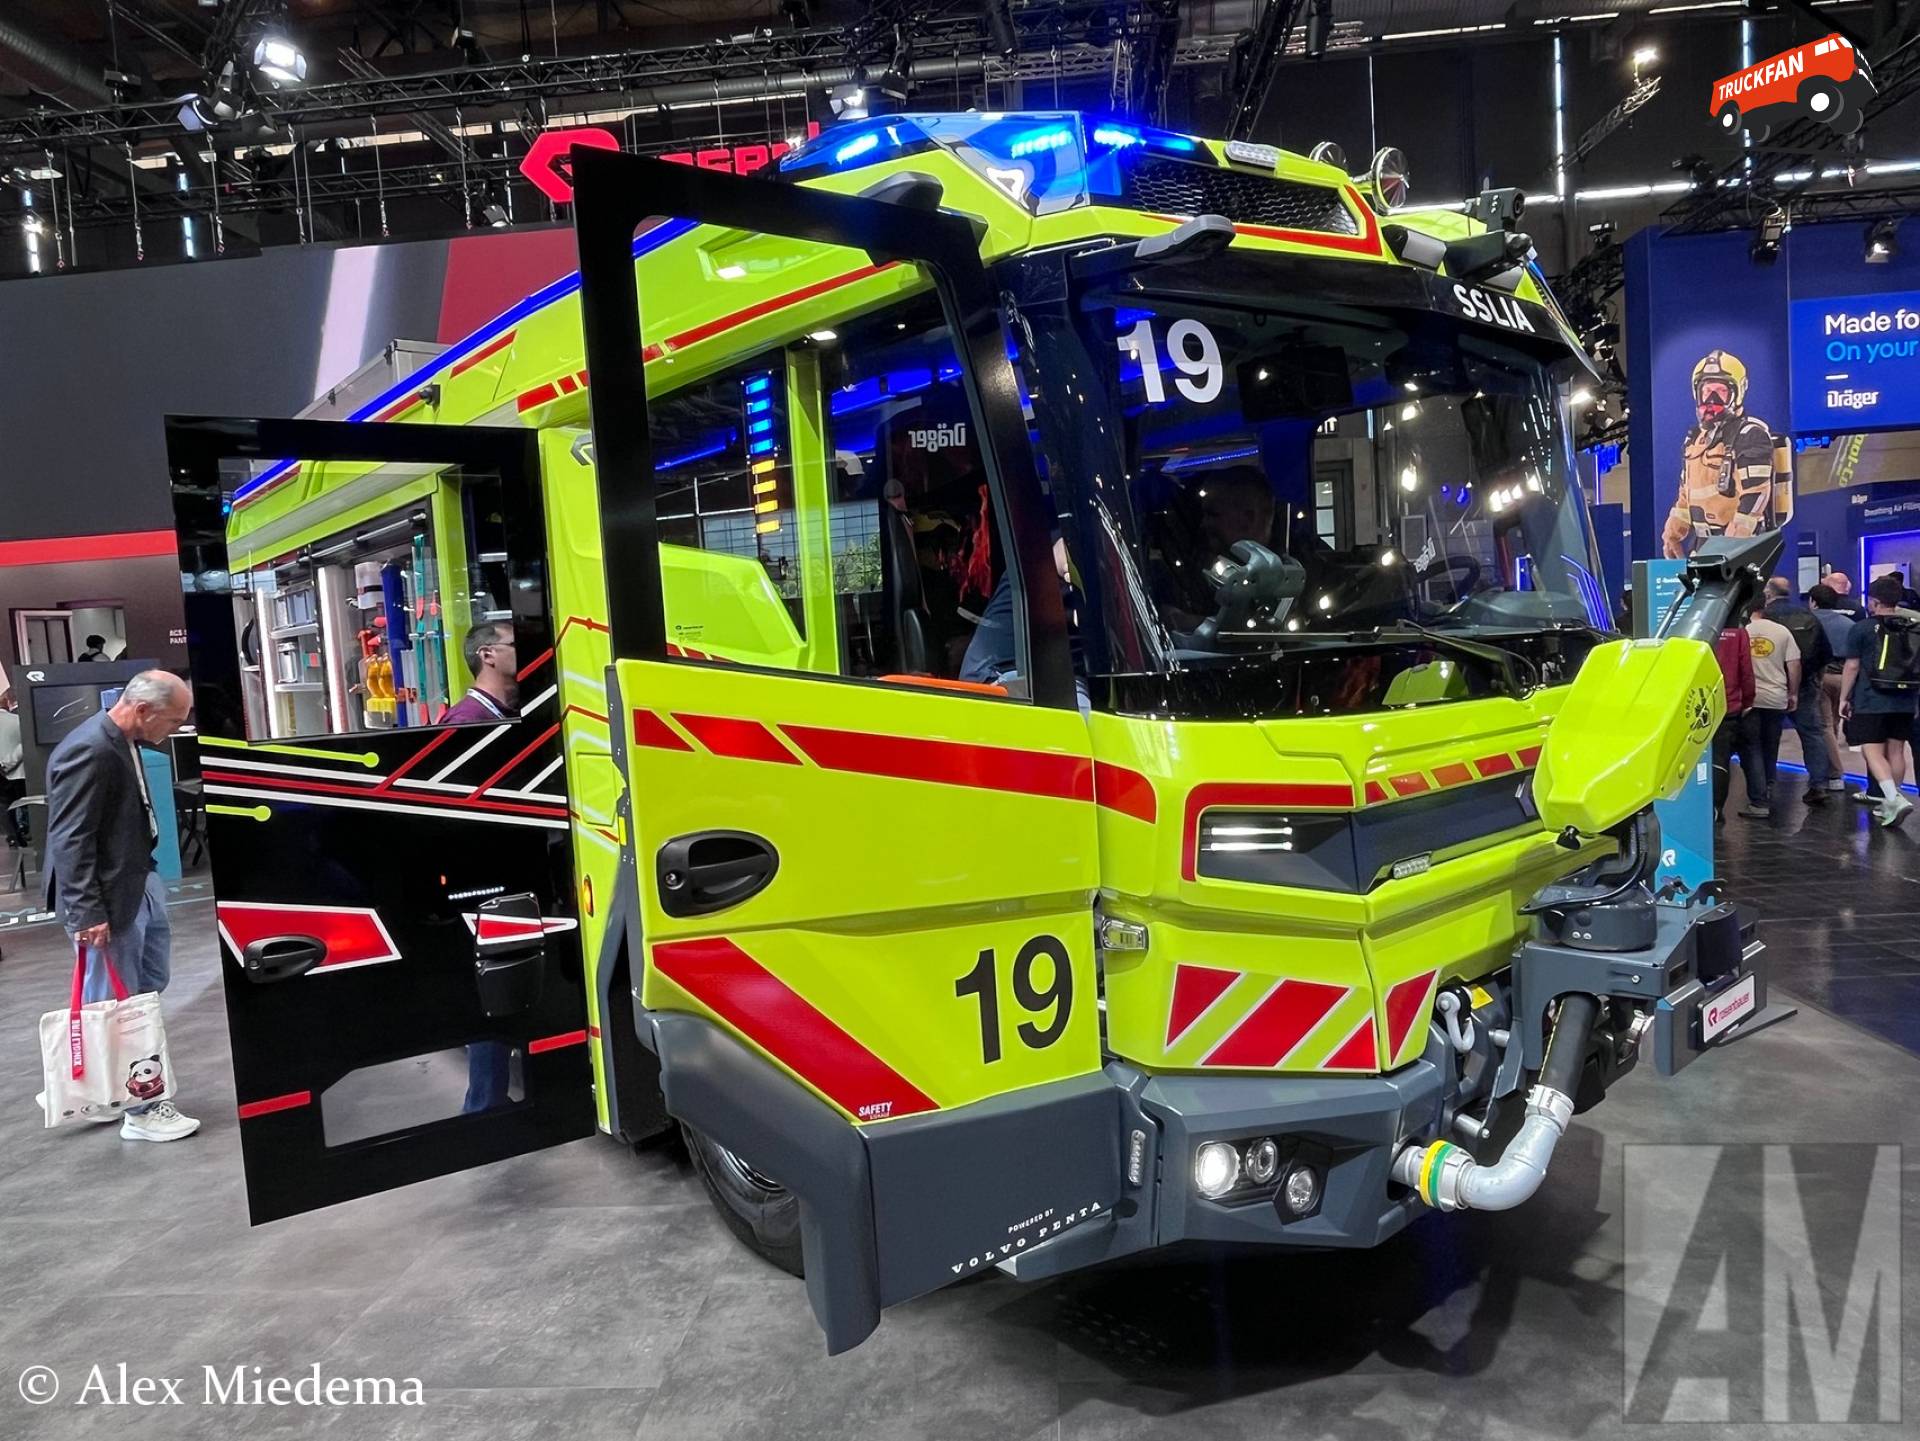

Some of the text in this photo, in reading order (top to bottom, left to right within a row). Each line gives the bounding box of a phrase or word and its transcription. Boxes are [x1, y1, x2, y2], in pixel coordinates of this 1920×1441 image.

[1453, 284, 1536, 333] SSLIA
[1825, 311, 1891, 335] Made
[1117, 319, 1223, 403] 19
[1826, 340, 1919, 364] On your
[1827, 389, 1879, 410] Dräger
[955, 934, 1073, 1065] 19
[858, 1101, 893, 1117] SAFETY
[1008, 1207, 1054, 1234] POWERED BY
[951, 1201, 1101, 1274] VOLVO PENTA
